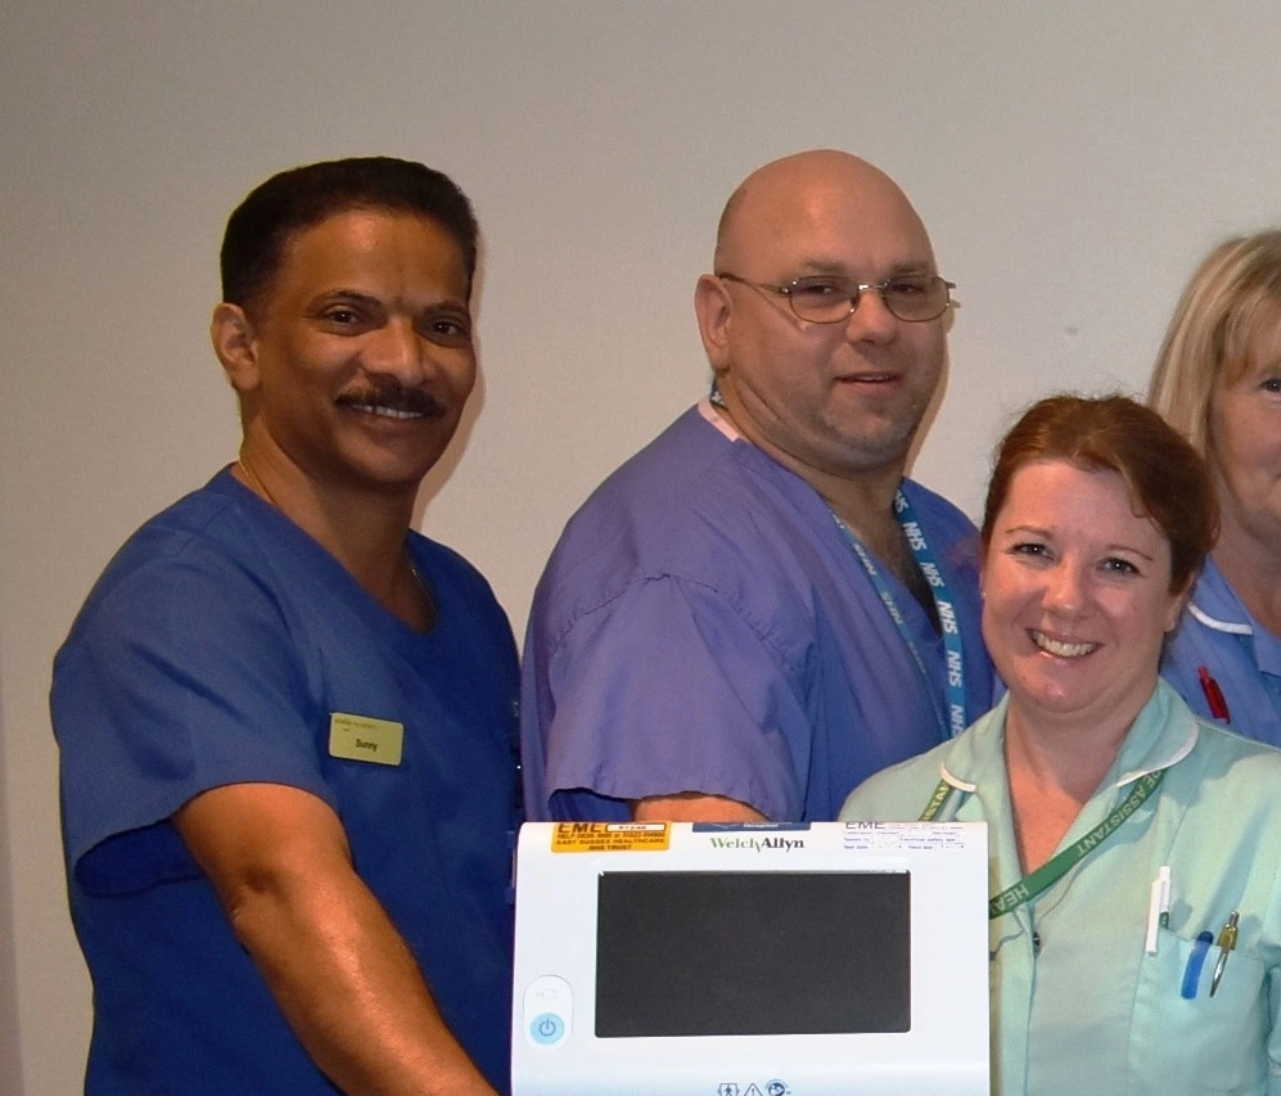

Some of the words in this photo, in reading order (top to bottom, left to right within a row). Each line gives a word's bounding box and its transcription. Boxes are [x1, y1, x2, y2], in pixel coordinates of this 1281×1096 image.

[902, 521, 927, 551] NHS
[919, 561, 945, 588] NHS
[937, 600, 958, 634] NHS
[947, 650, 962, 687] NHS
[1078, 785, 1146, 856] ASSISTANT
[710, 837, 804, 852] WelchAllyn
